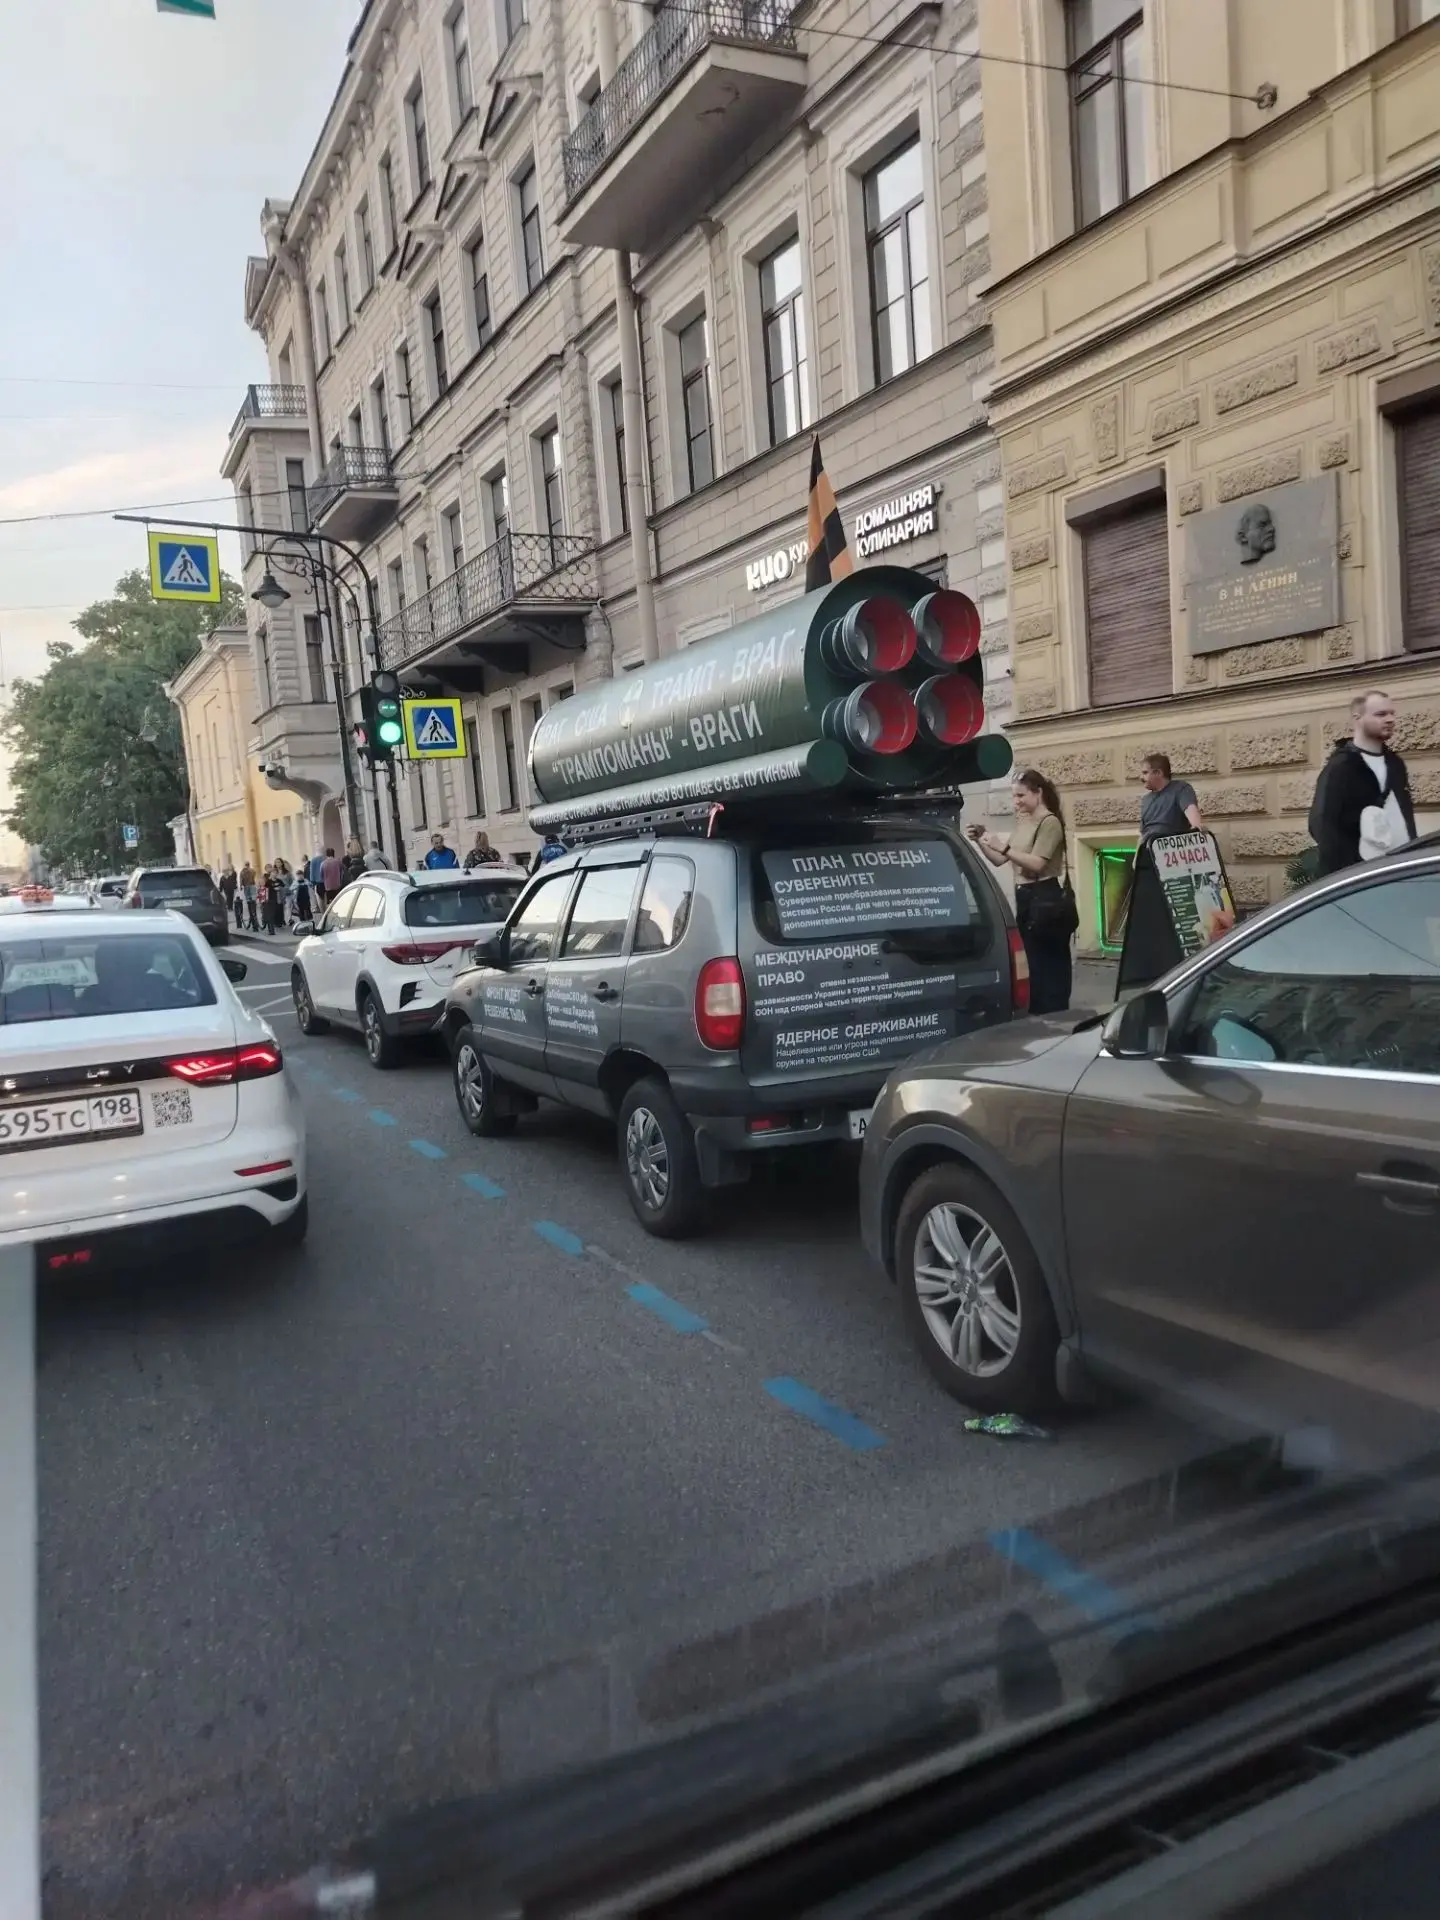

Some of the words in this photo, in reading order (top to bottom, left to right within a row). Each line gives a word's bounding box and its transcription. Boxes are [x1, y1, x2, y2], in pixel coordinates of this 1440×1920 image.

[855, 485, 932, 538] ДОМАШНЯЯ
[856, 511, 933, 558] КУЛИНАРИЯ
[575, 703, 608, 737] США
[652, 659, 718, 710] ТРАМП
[731, 627, 796, 683] ВРАГ
[689, 700, 763, 752] ВРАГИ
[653, 785, 670, 803] СВО
[671, 782, 685, 800] ВО
[685, 778, 714, 797] ГЛАВЕ
[714, 776, 722, 792] С
[724, 772, 743, 791] В.В.
[744, 759, 801, 786] ПУТИНЫМ
[1157, 833, 1208, 850] ПРОДУКТЫ
[792, 854, 845, 873] ПЛАН
[851, 849, 931, 868] ПОБЕДЫ:
[1164, 852, 1179, 867] 24
[1179, 847, 1211, 865] ЧАСА
[774, 872, 875, 893] СУВЕРЕНИТЕТ
[778, 894, 833, 907] Суверенные
[902, 884, 954, 896] политической
[781, 906, 819, 918] системы
[855, 901, 871, 912] для
[872, 900, 890, 909] чего
[783, 916, 855, 931] дополнительные
[856, 911, 906, 922] полномочия
[923, 907, 951, 918] Путину
[755, 943, 879, 967] МЕЖДУНАРОДНОЕ
[754, 992, 813, 1006] независимости
[814, 987, 846, 999] Украины
[877, 979, 925, 992] установление
[925, 974, 955, 984] контроля
[757, 970, 805, 988] ПРАВО
[820, 979, 846, 989] отмена
[847, 972, 889, 985] незаконной
[755, 1007, 773, 1017] ООН
[790, 1000, 823, 1012] спорной
[824, 998, 850, 1008] частью
[893, 988, 923, 999] Украины
[776, 1027, 839, 1047] ЯДЕРНОЕ
[845, 1013, 939, 1039] СДЕРЖИВАНИЕ
[776, 1045, 827, 1057] Нацеливание
[828, 1042, 843, 1050] или
[844, 1038, 868, 1051] угроза
[869, 1033, 915, 1046] нацеливания
[915, 1027, 947, 1039] ядерного
[817, 1051, 861, 1063] территорию
[862, 1047, 880, 1057] США
[92, 1097, 132, 1118] 198
